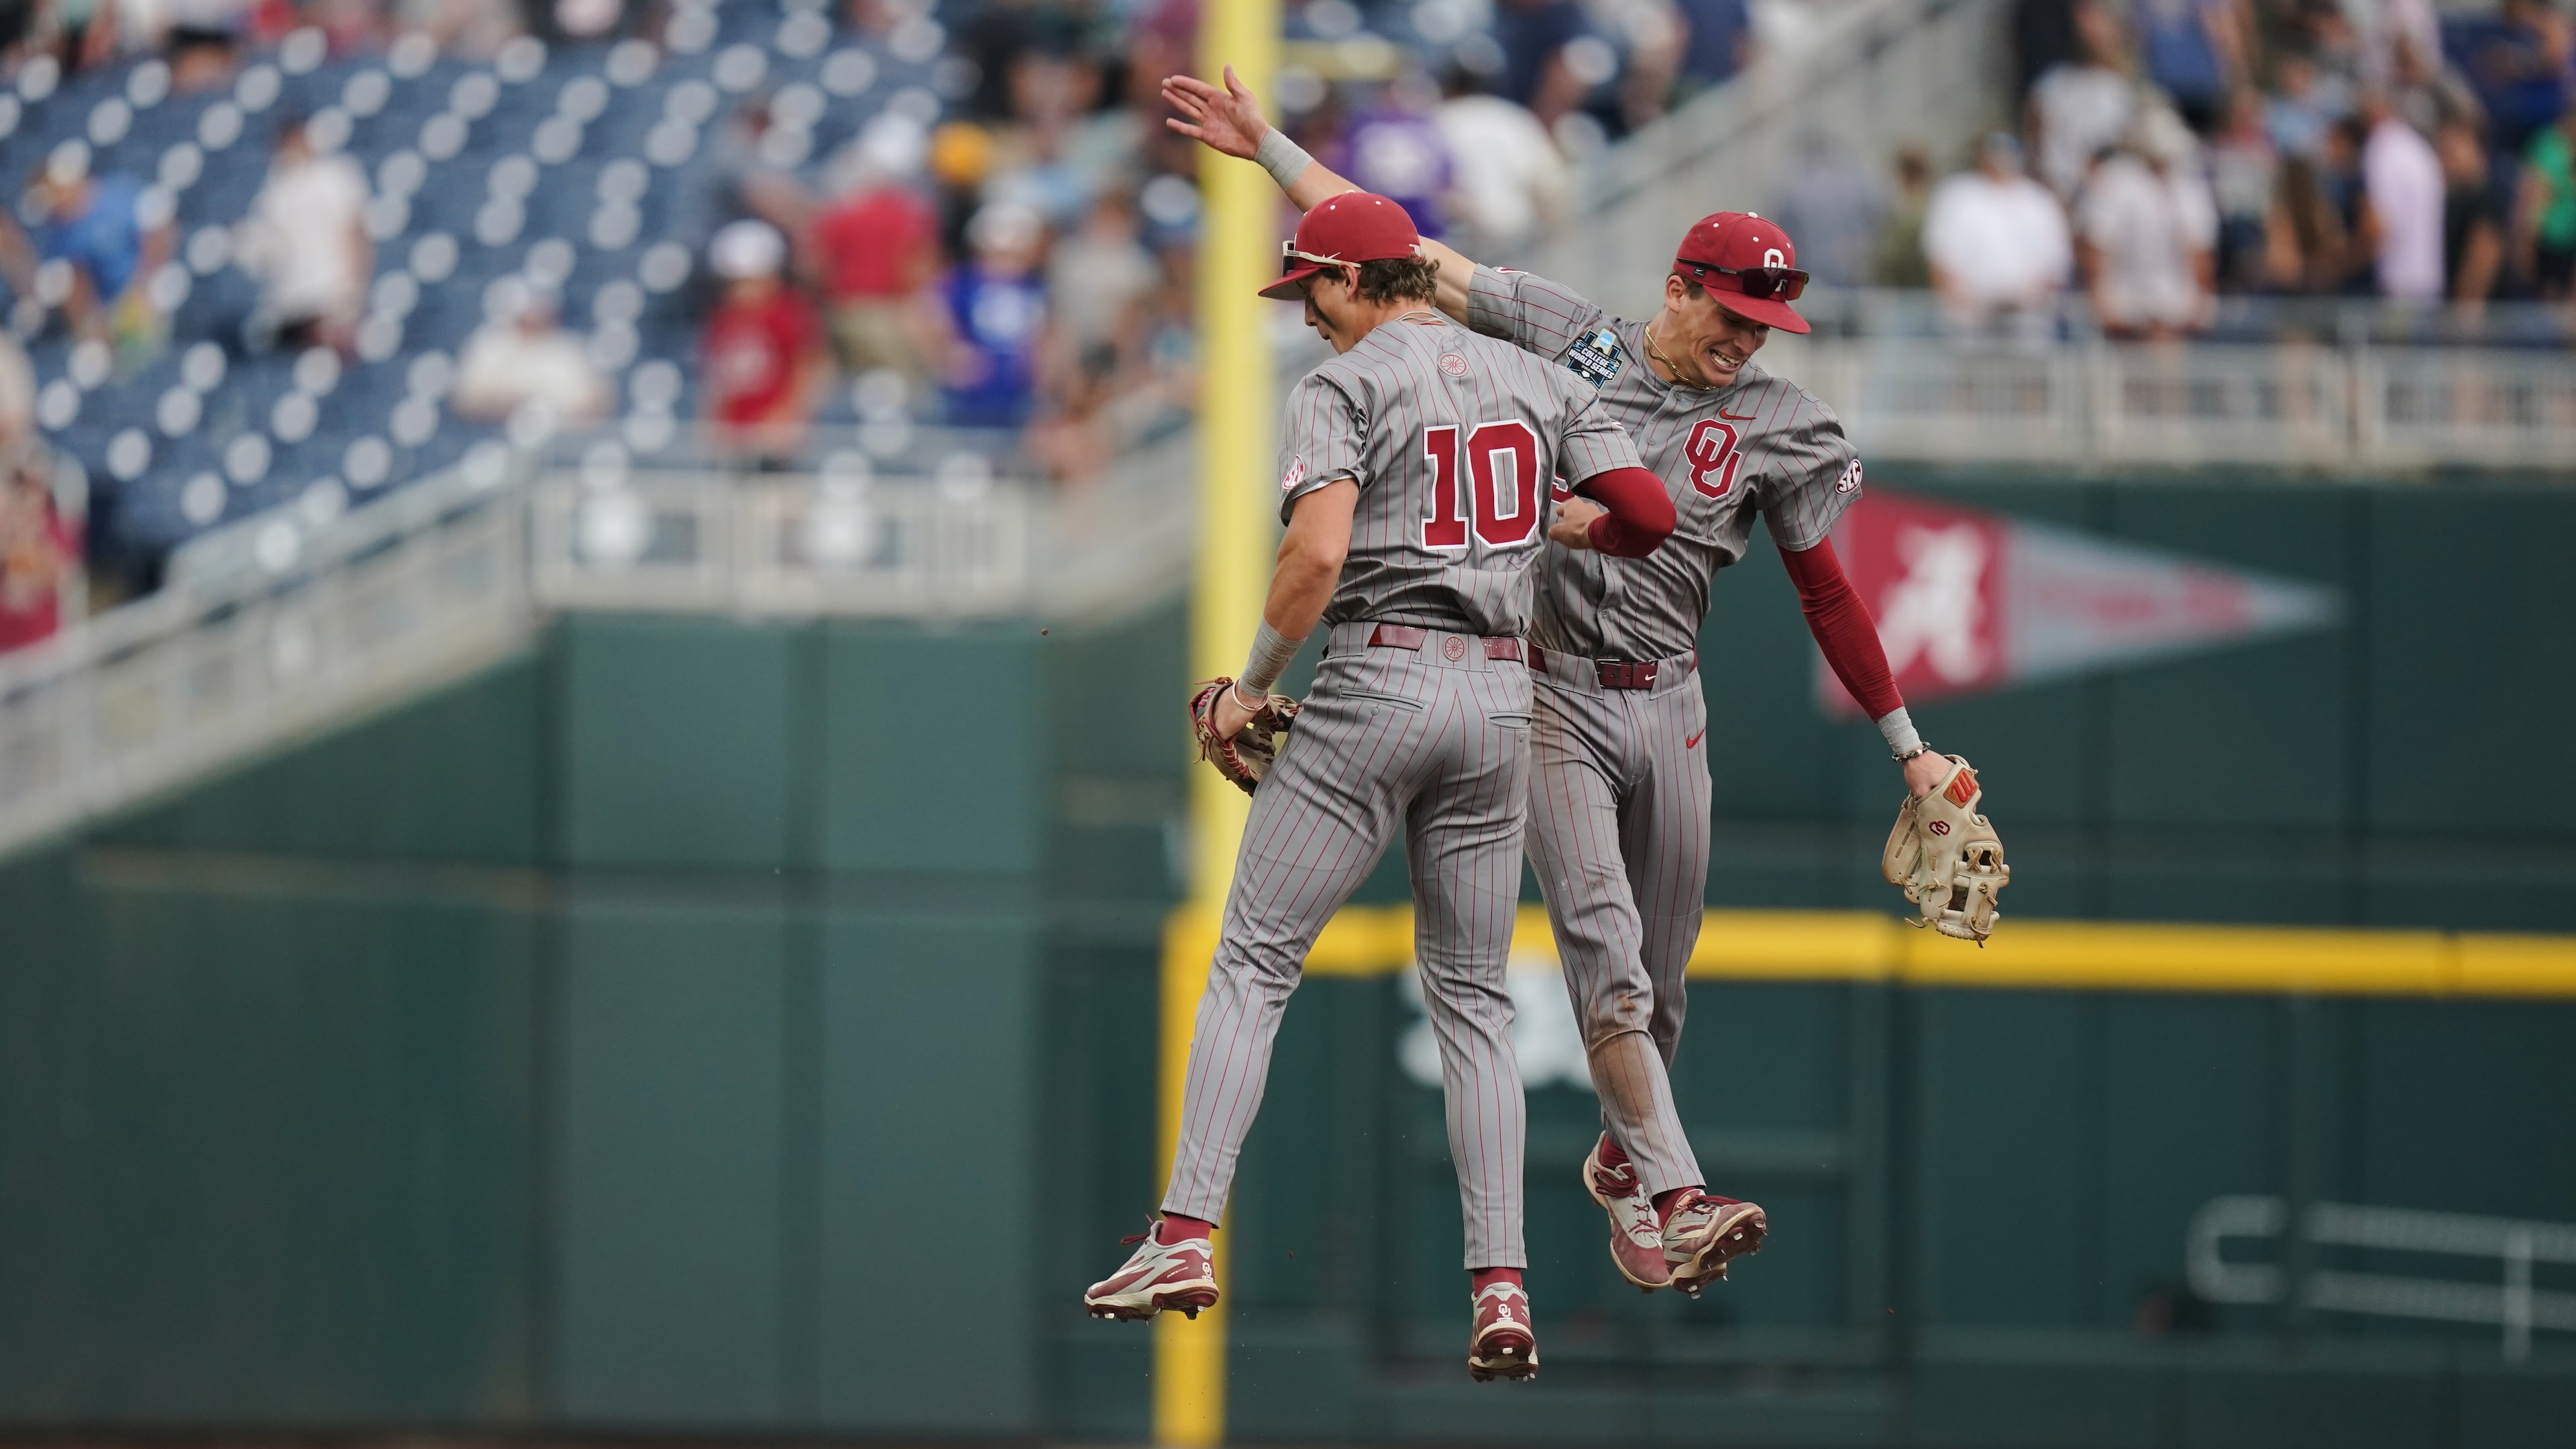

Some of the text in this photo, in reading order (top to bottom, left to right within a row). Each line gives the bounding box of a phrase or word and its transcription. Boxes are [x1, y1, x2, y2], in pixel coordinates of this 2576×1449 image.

[1568, 349, 1591, 366] WORLD
[1590, 363, 1615, 379] SERIES
[1581, 347, 1609, 368] COLLEGE
[1682, 419, 1742, 500] OU
[1421, 419, 1540, 549] 10
[1837, 462, 1860, 492] SEC
[1498, 1303, 1511, 1318] OU
